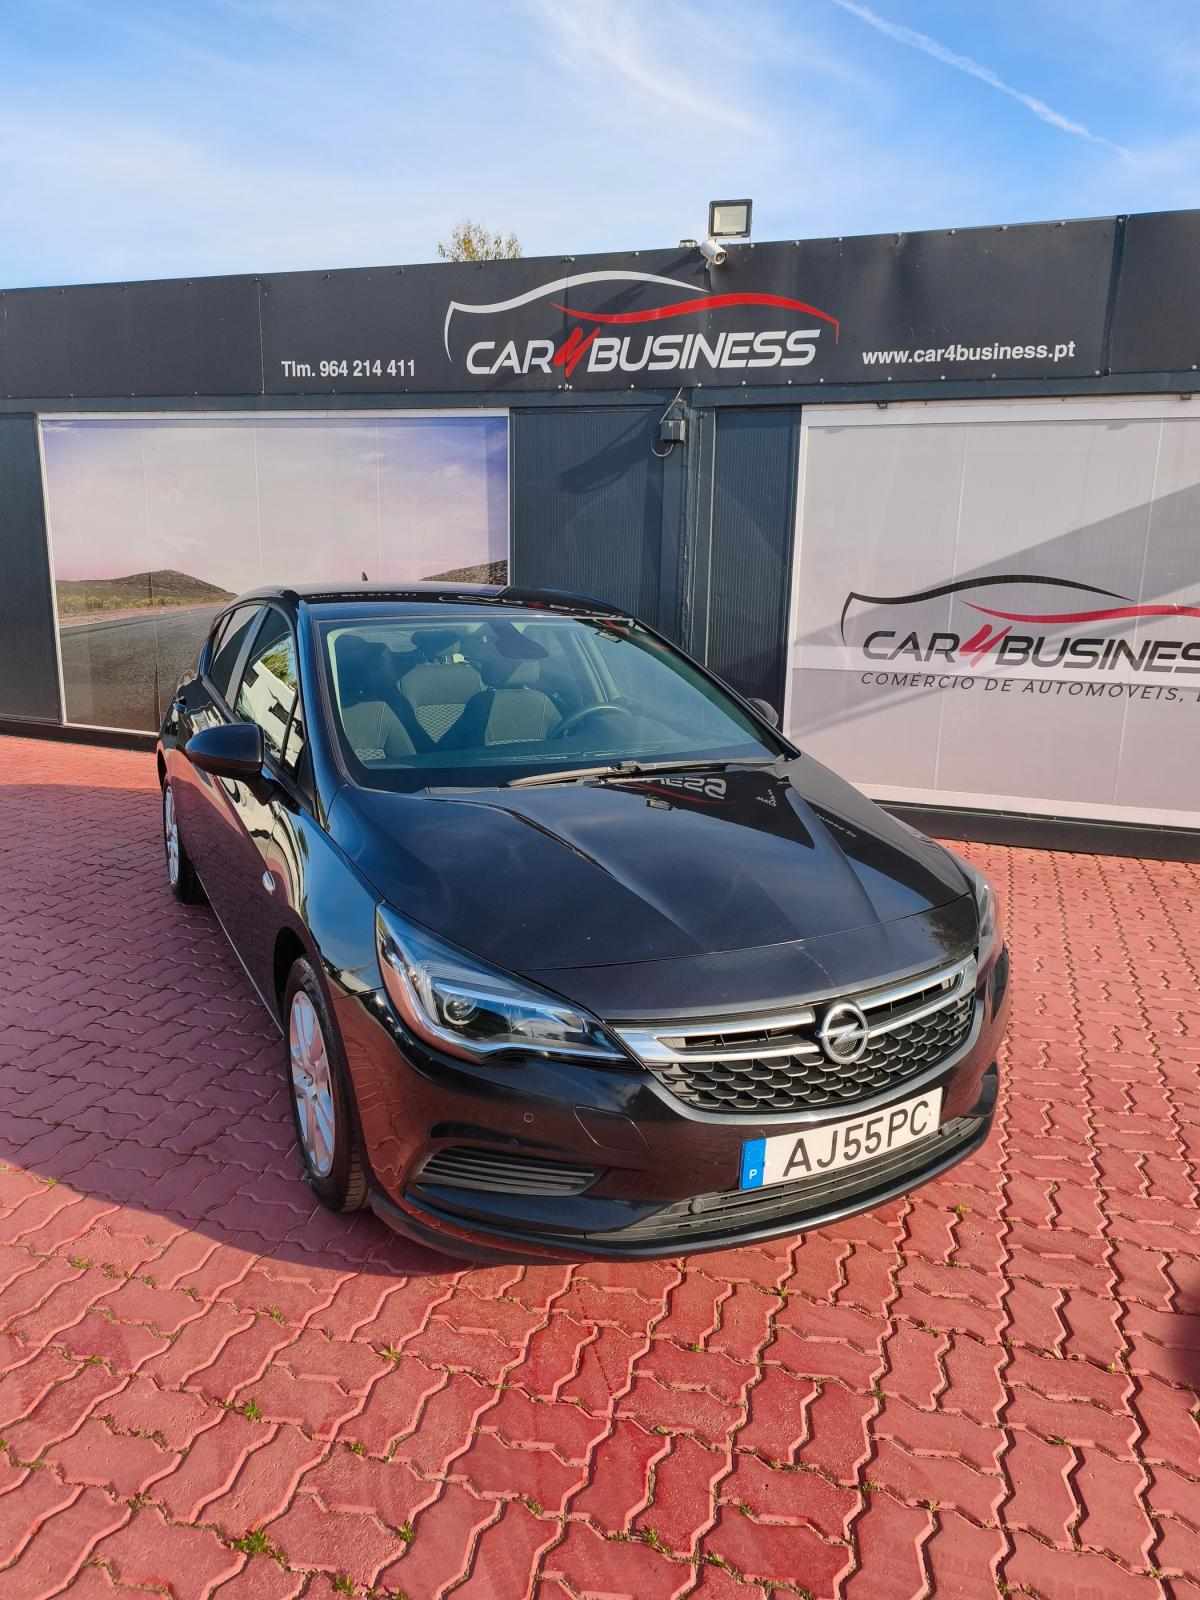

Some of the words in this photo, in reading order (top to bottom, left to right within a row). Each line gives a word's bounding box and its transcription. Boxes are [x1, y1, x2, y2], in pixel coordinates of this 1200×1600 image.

[862, 340, 1076, 365] www.car4business.pt
[281, 360, 316, 377] Tlm.
[320, 360, 348, 377] 964
[353, 359, 382, 377] 214
[387, 359, 415, 377] 411
[984, 678, 1014, 692] DE
[782, 1100, 929, 1177] AJ55PC
[749, 1169, 758, 1180] P
